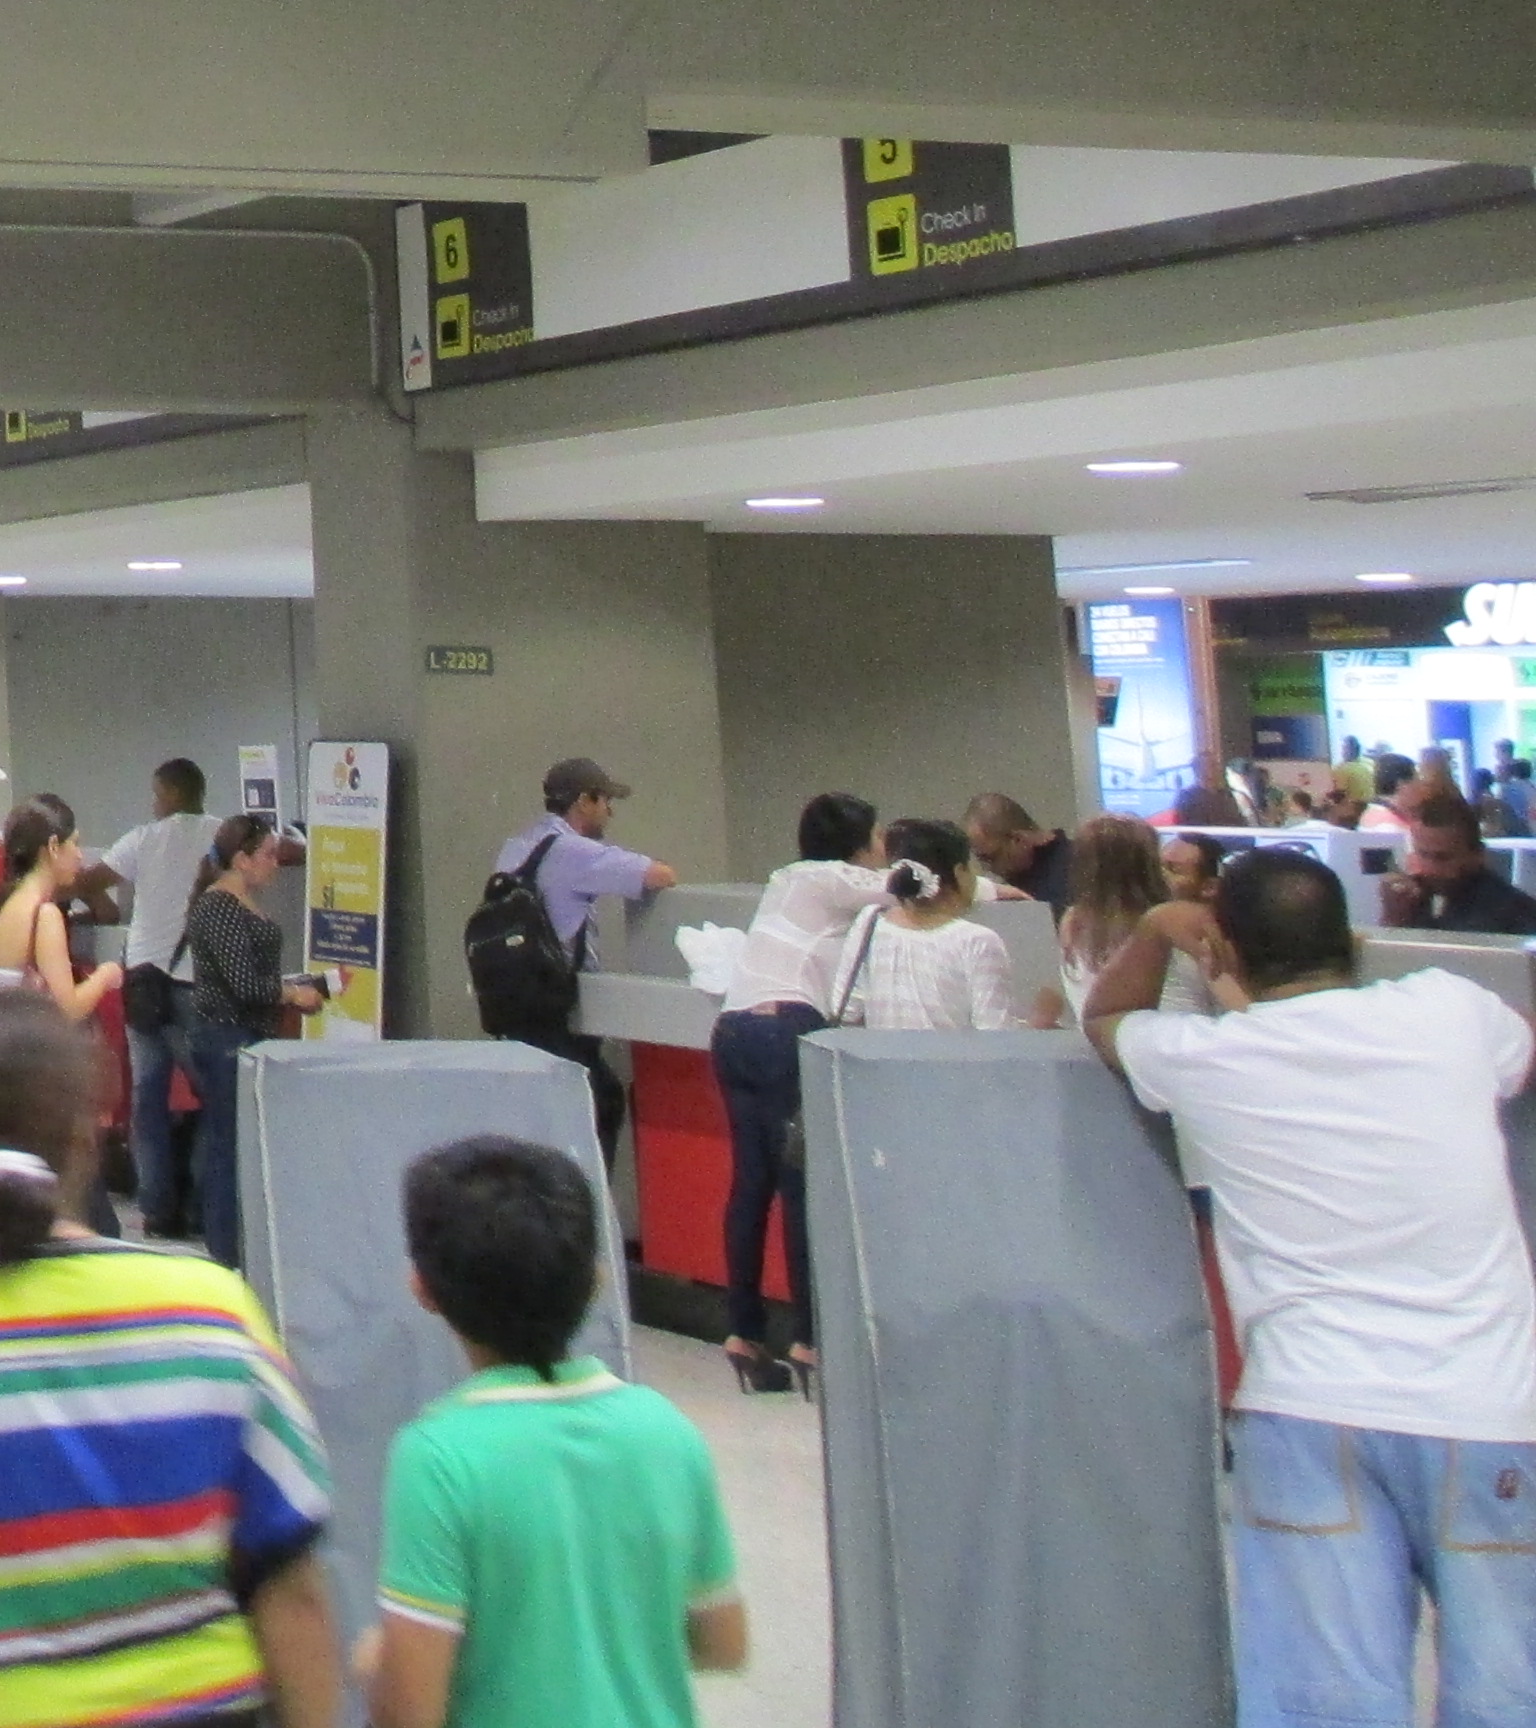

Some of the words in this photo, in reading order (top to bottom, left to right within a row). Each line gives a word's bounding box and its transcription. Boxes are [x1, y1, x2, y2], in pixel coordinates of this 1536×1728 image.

[920, 205, 971, 234] Check
[445, 233, 459, 269] 6
[923, 231, 1015, 268] Despacho
